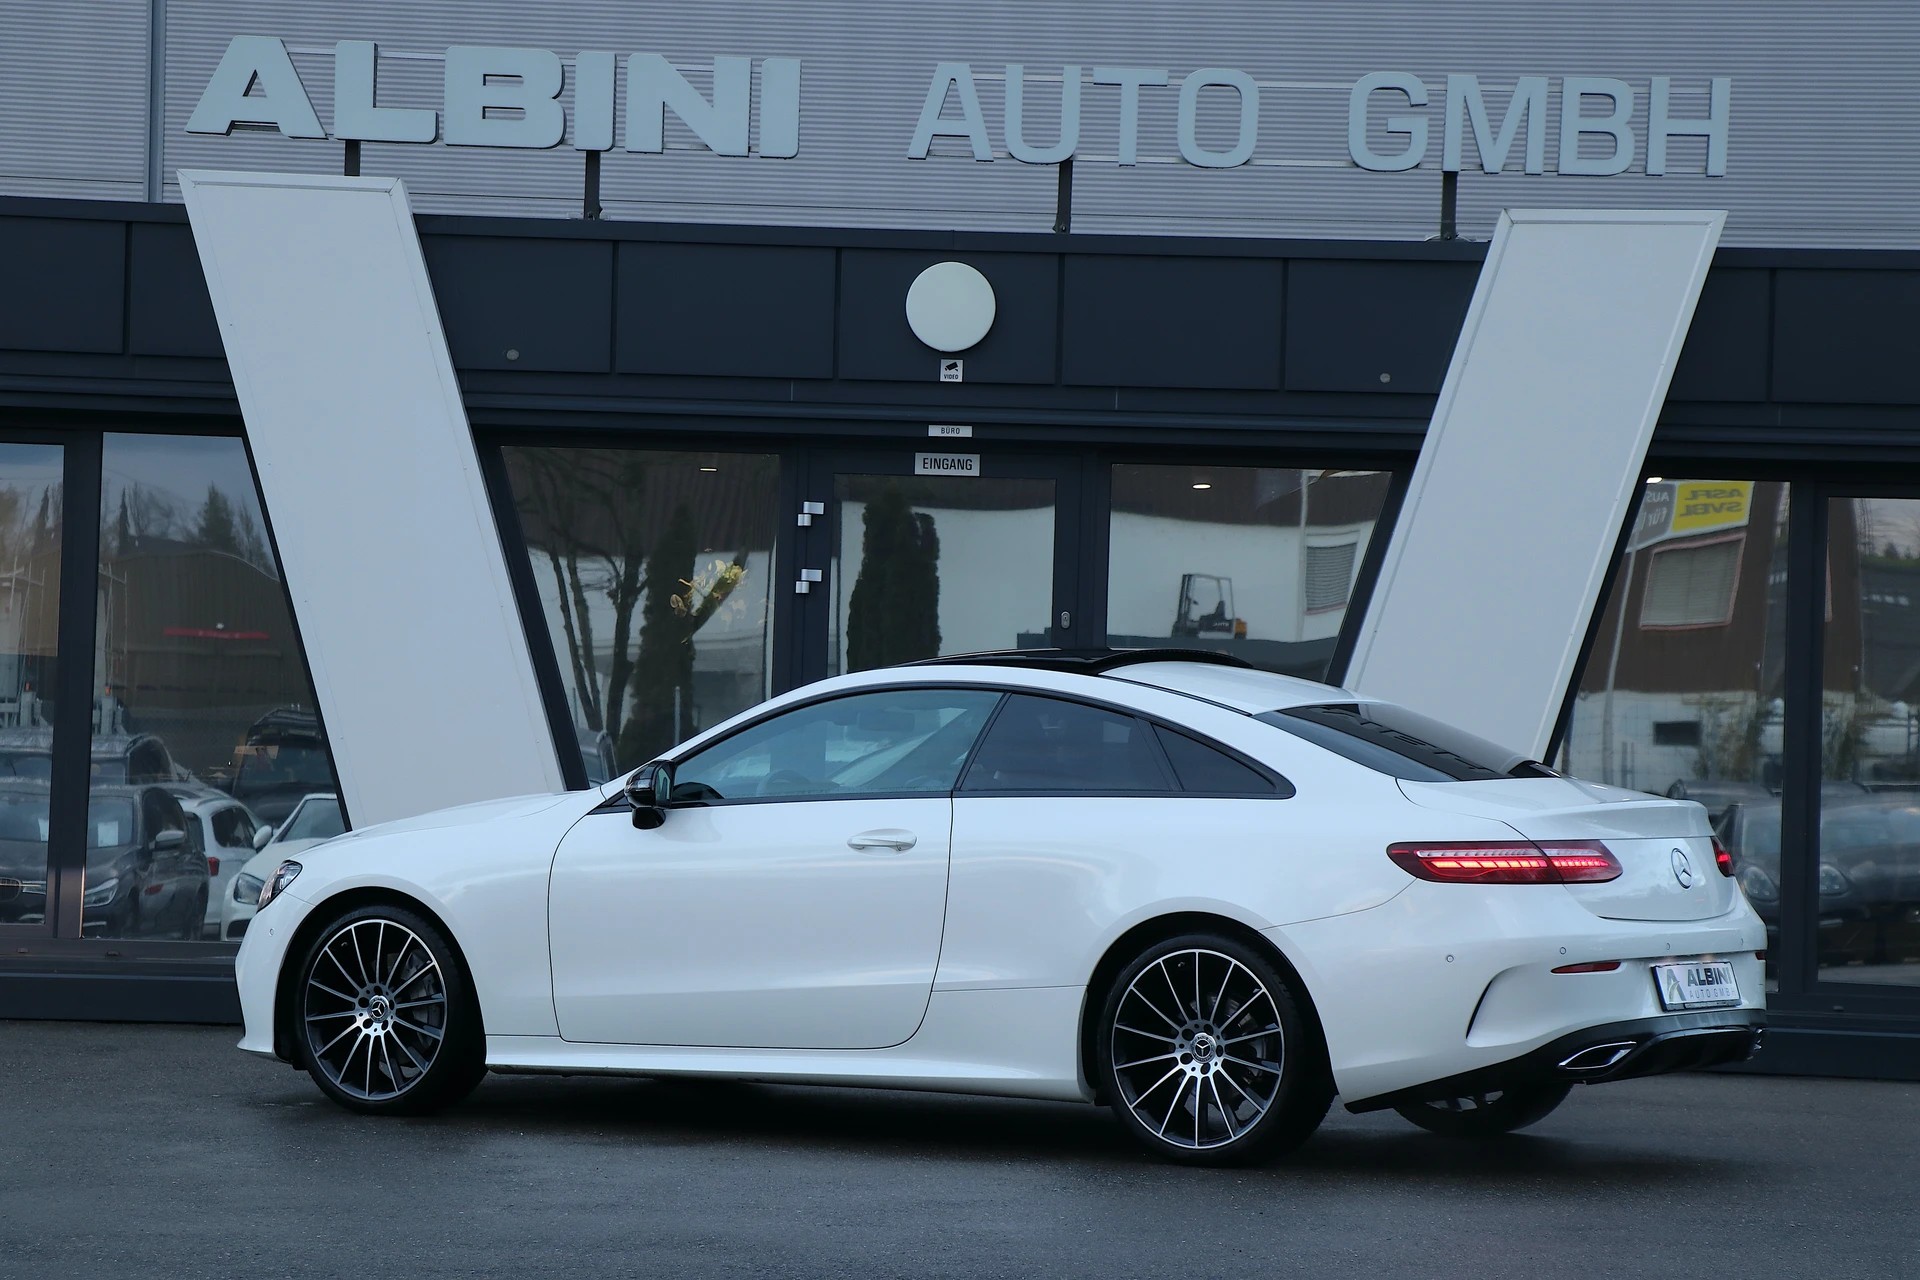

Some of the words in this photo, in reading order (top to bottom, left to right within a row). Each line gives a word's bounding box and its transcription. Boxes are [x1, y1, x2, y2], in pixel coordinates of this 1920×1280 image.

[185, 35, 800, 158] ALBINI
[907, 63, 1260, 168] AUTO
[1348, 70, 1731, 176] GMBH
[940, 426, 960, 435] BÜRO
[922, 457, 973, 471] EINGANG
[1687, 967, 1732, 986] ALBINI
[1689, 988, 1710, 999] AUTO
[1714, 988, 1735, 998] GMBH
